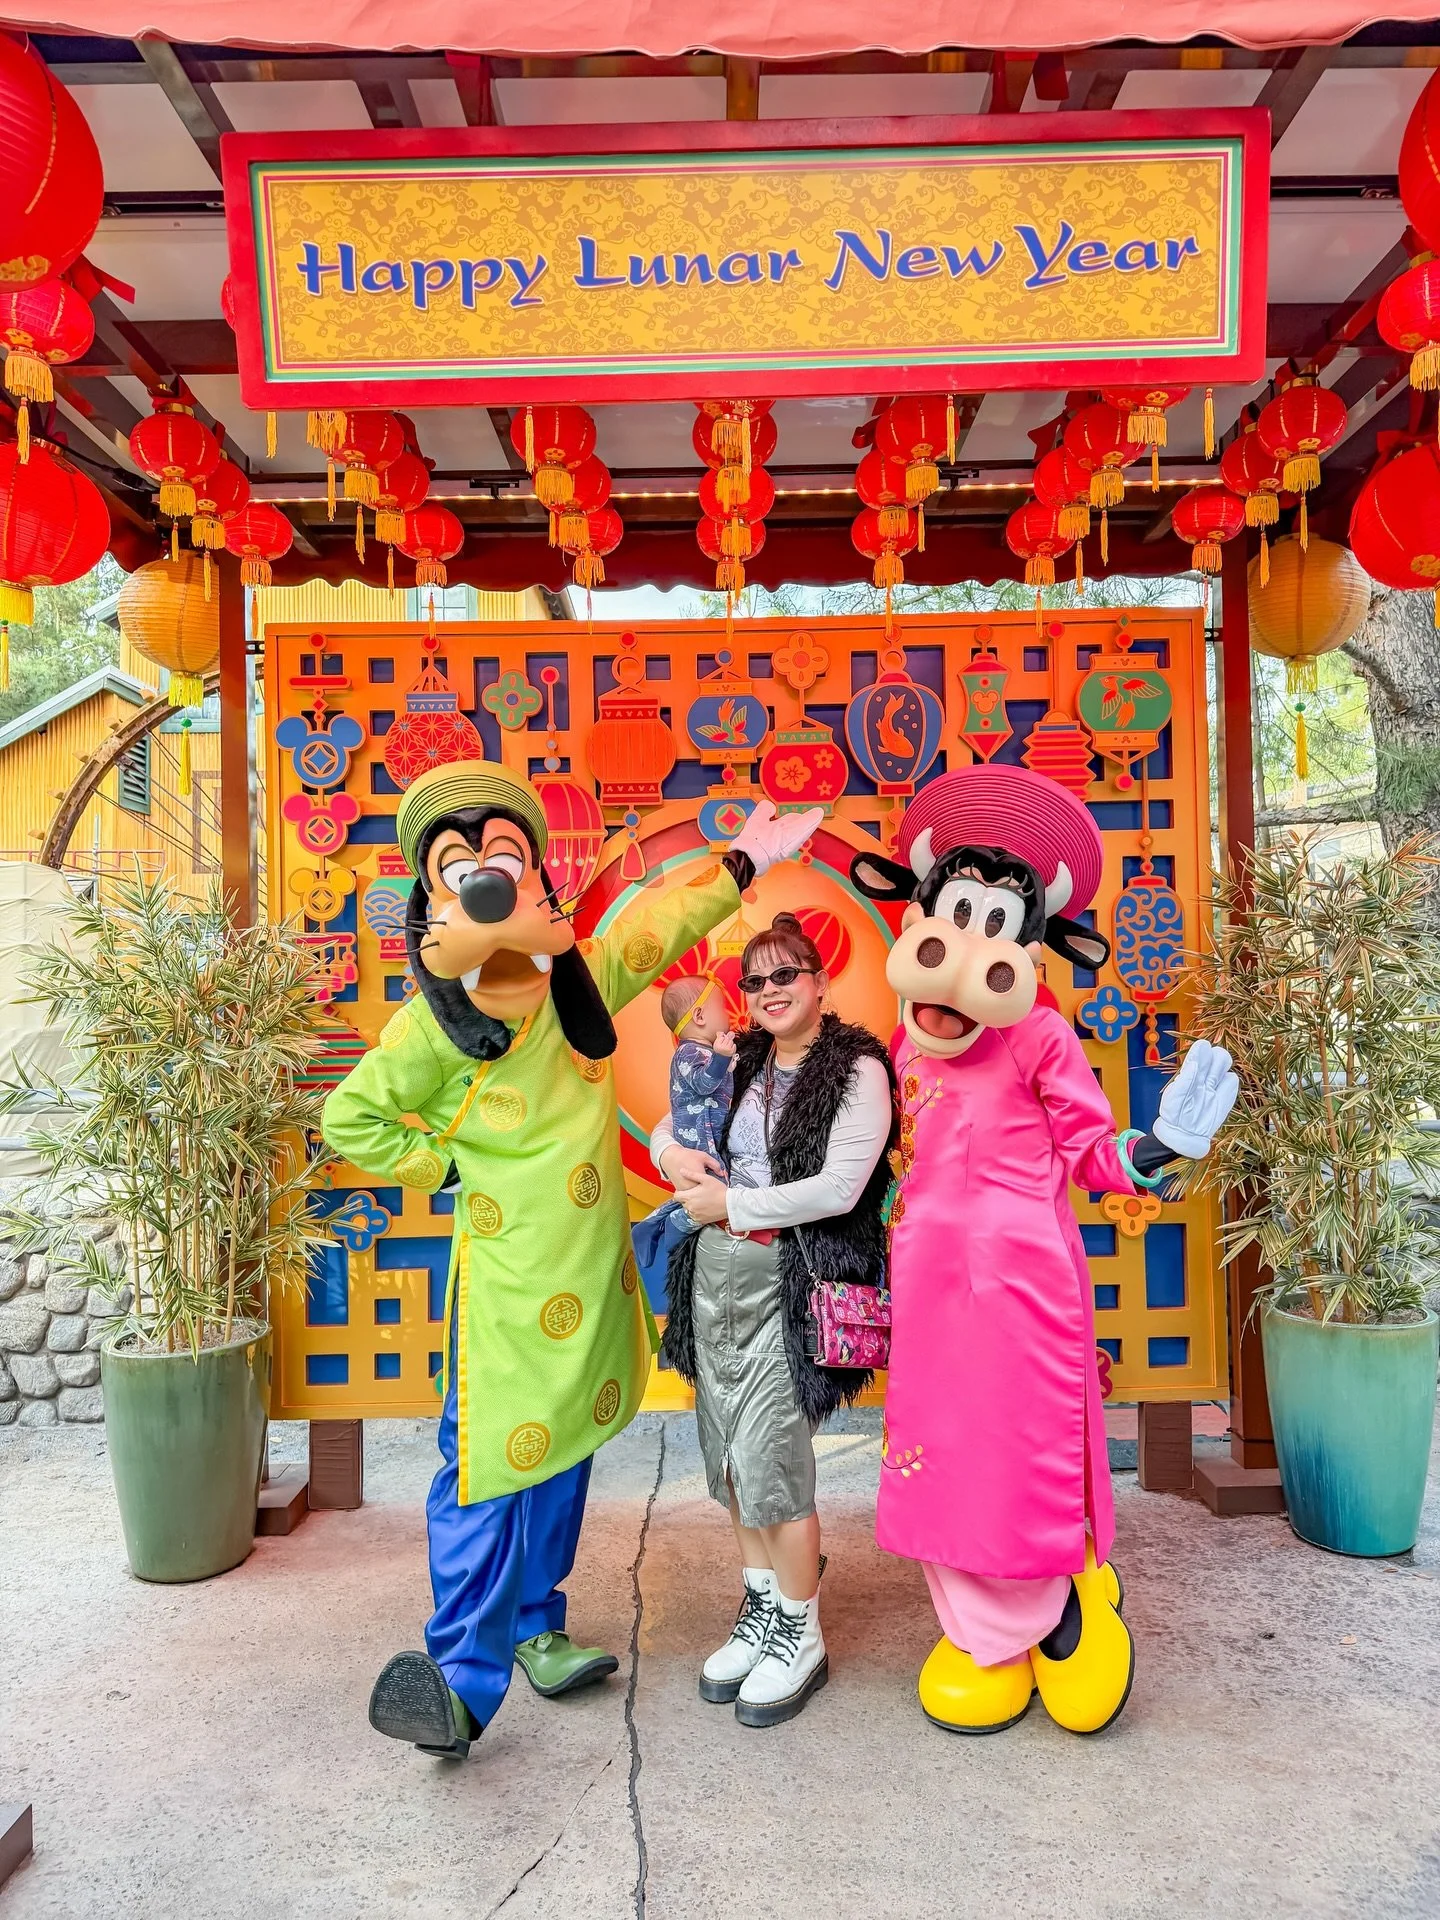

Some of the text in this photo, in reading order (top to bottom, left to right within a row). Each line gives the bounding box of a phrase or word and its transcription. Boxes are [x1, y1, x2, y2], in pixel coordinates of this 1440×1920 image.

[297, 223, 1198, 309] Happy Lunar New Year
